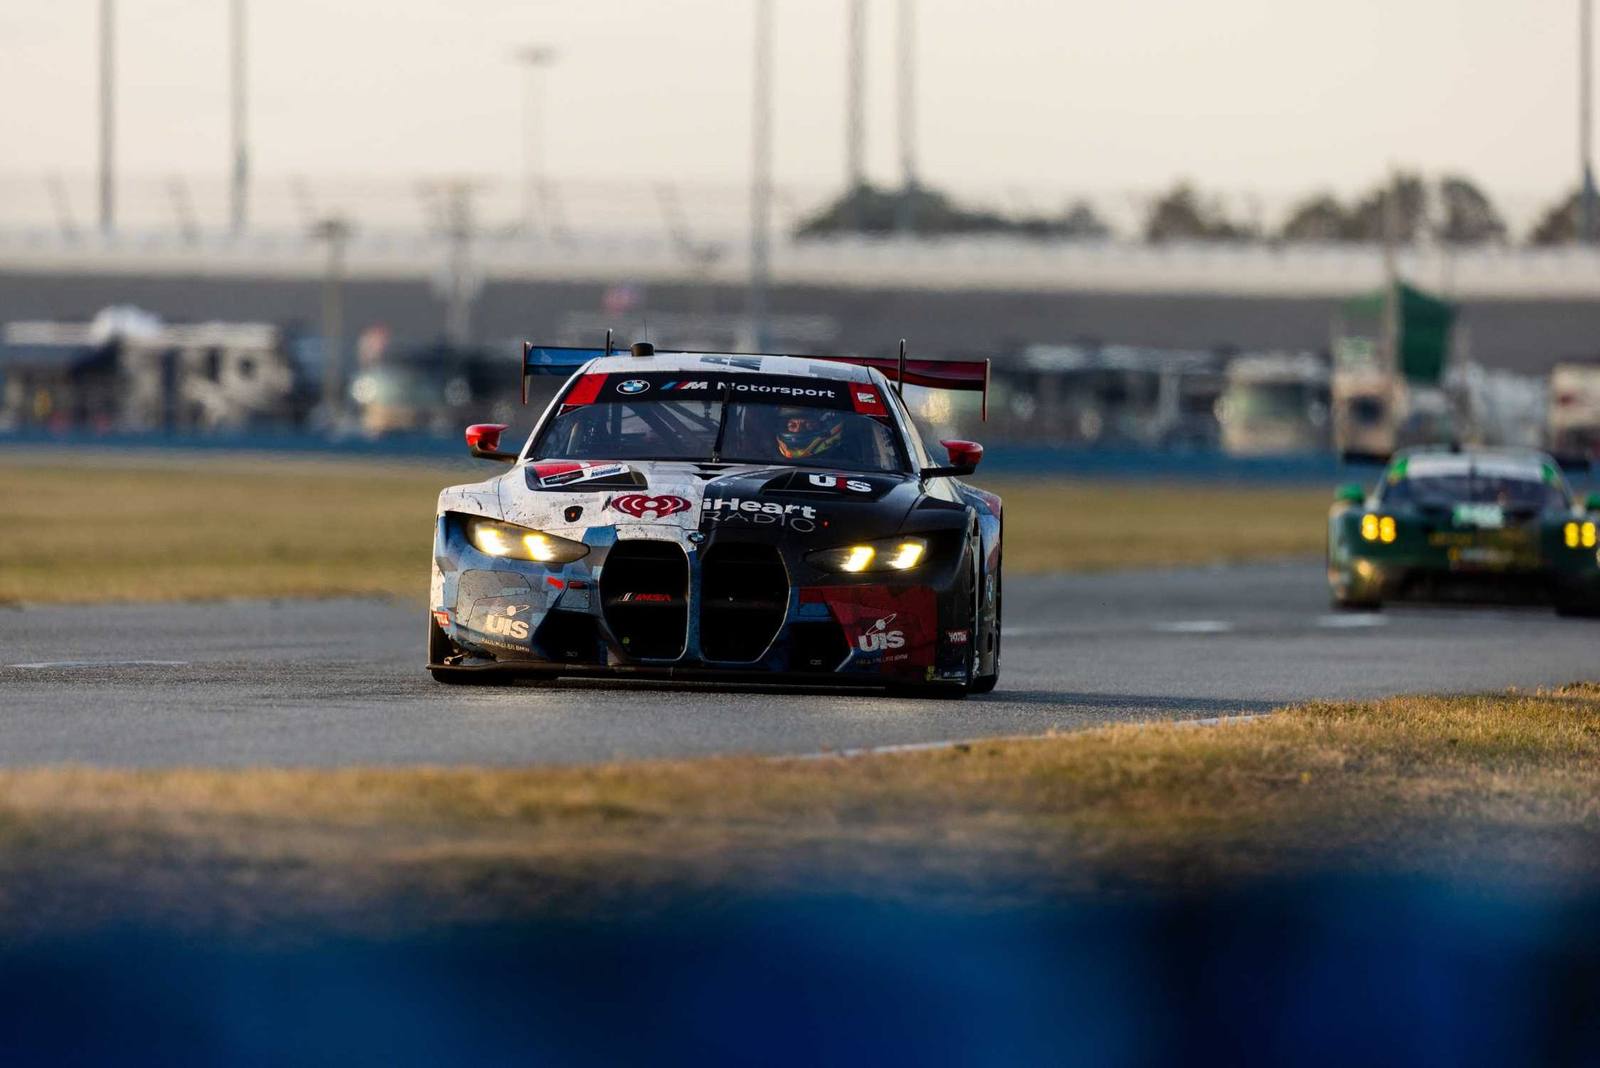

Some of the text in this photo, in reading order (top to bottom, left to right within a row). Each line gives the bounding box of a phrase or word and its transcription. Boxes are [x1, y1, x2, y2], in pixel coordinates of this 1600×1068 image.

[717, 381, 836, 399] Motorsport
[702, 497, 817, 520] iHeart
[701, 510, 816, 533] RADIO
